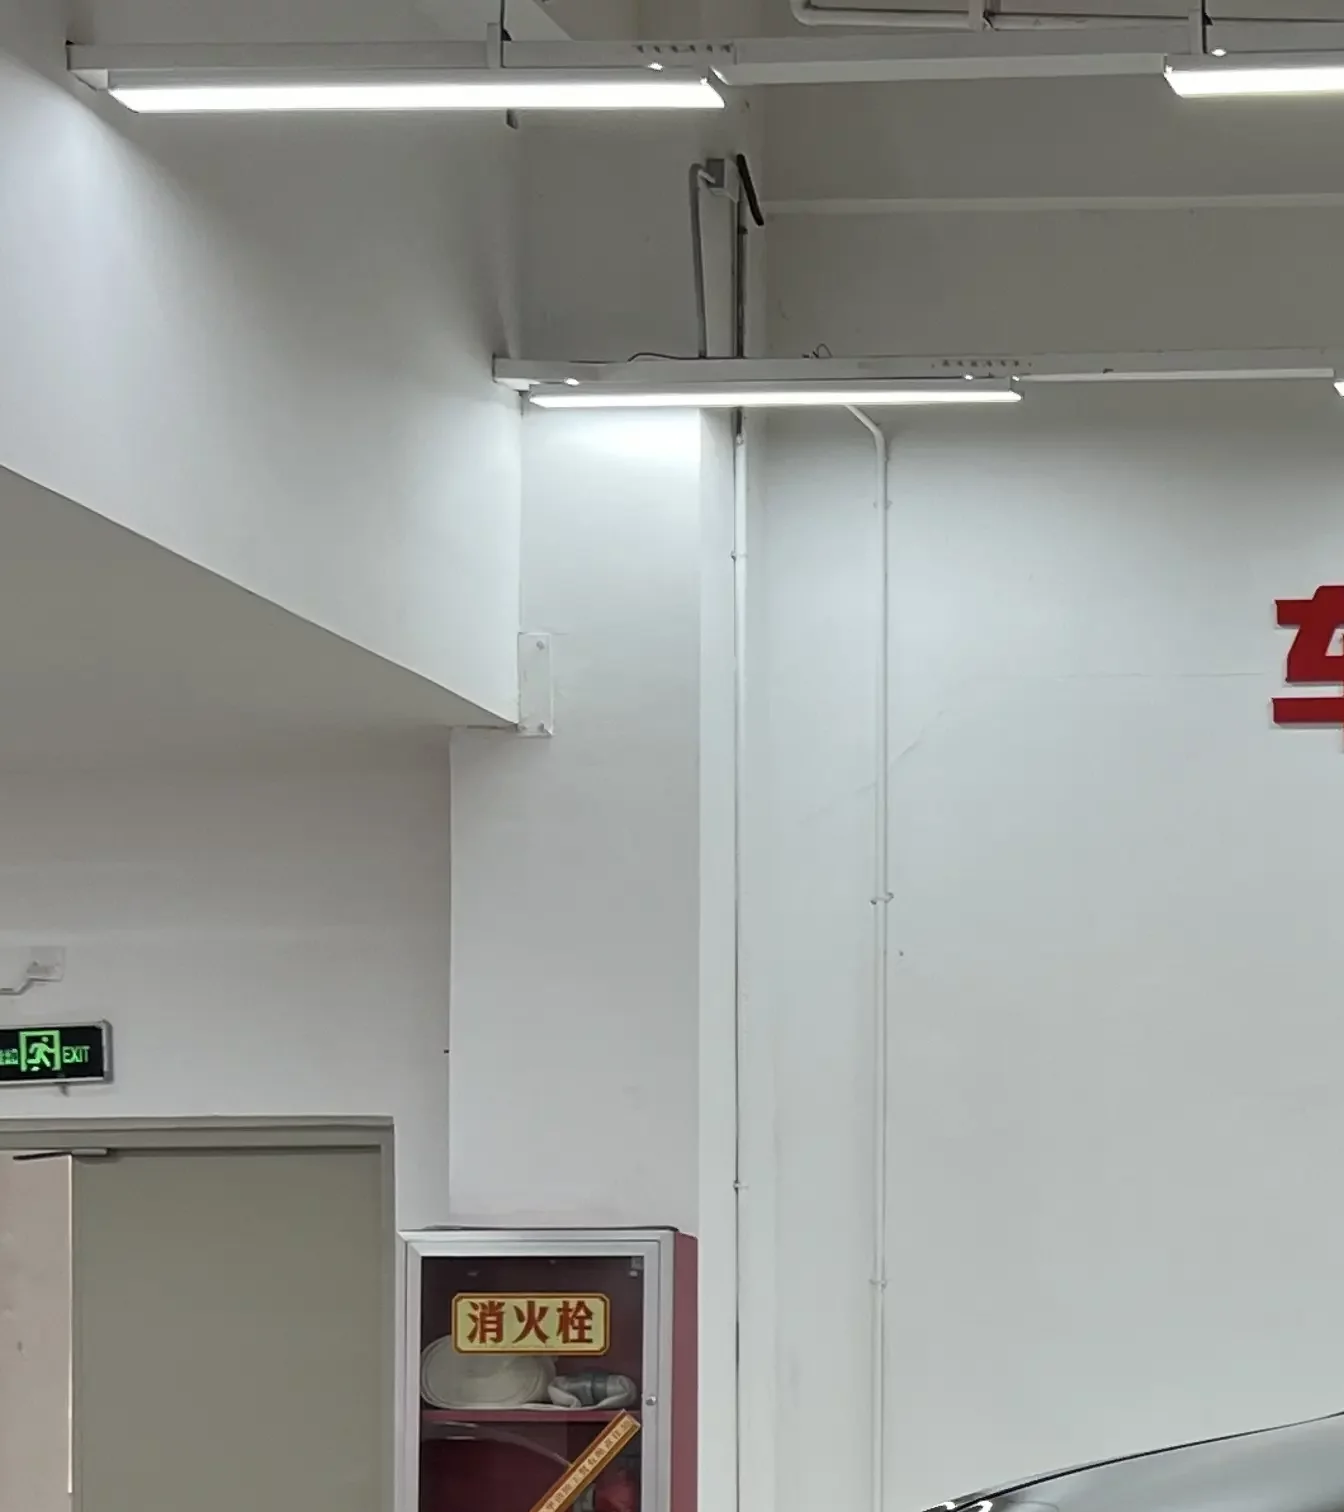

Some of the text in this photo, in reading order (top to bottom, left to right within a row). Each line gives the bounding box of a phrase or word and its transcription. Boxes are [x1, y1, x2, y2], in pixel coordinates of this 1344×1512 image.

[62, 1045, 91, 1064] EXIT
[467, 1300, 593, 1344] 消火栓
